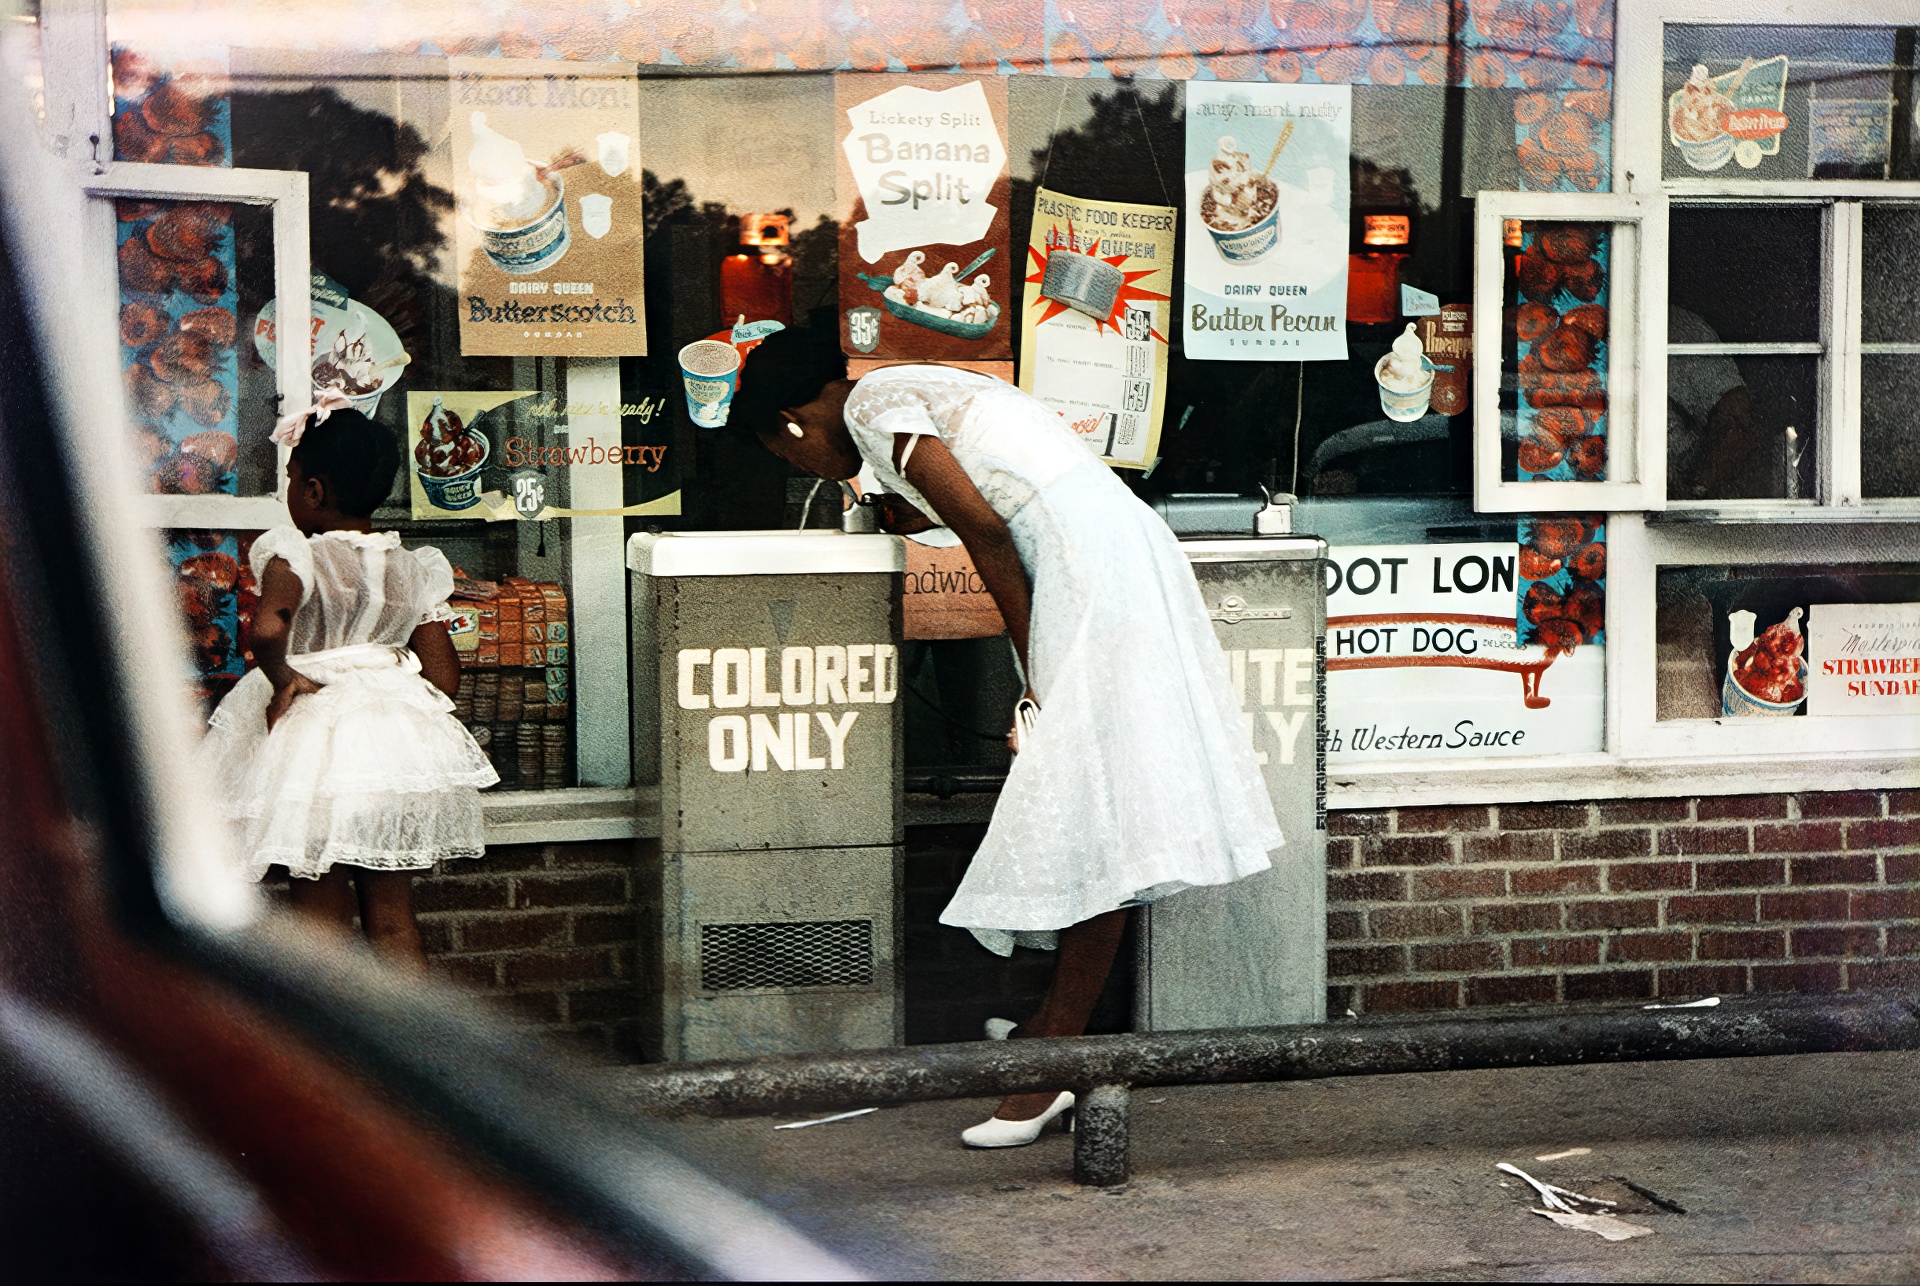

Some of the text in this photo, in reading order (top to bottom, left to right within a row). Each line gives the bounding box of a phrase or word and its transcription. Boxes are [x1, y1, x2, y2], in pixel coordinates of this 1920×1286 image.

[869, 110, 982, 129] Lickety Split
[858, 132, 991, 165] Banana
[877, 169, 971, 211] Split
[1085, 208, 1119, 227] FOOD
[1121, 212, 1174, 233] KEEPER
[1100, 238, 1157, 260] QUEEN
[1223, 284, 1309, 297] DAIRY QUEEN
[1190, 302, 1339, 333] Butter Pecan
[503, 436, 668, 474] Strawberry
[516, 478, 545, 513] 25¢
[902, 563, 983, 595] ndwic
[1433, 555, 1516, 594] LON
[1336, 628, 1399, 656] HOT
[1412, 628, 1479, 655] DOG
[677, 644, 899, 710] COLORED
[1229, 648, 1314, 706] ITE
[708, 711, 860, 773] ONLY
[1351, 724, 1443, 751] Western
[1445, 719, 1527, 749] Sauce
